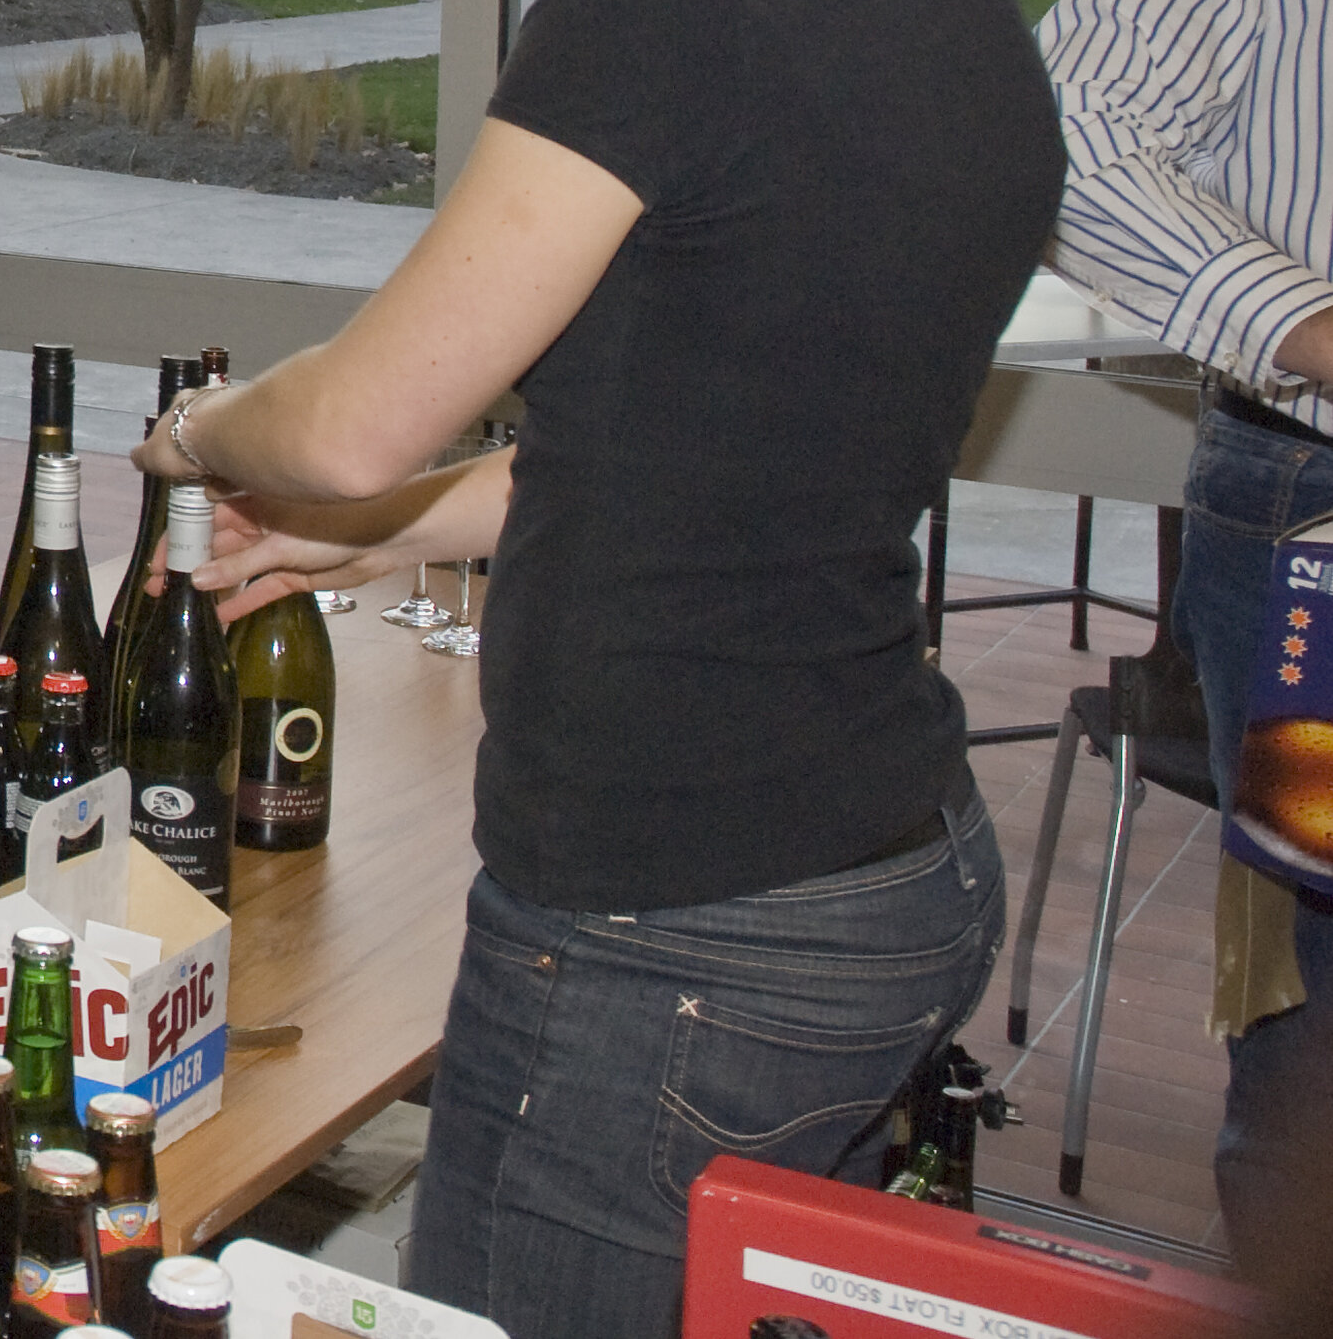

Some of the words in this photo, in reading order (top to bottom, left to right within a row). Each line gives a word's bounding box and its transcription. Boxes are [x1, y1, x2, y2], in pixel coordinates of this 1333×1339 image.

[1287, 556, 1322, 591] 12
[152, 823, 217, 839] CHALICE
[152, 1049, 203, 1112] LAGER
[810, 1270, 883, 1305] $50.00
[889, 1293, 965, 1327] FLOAT
